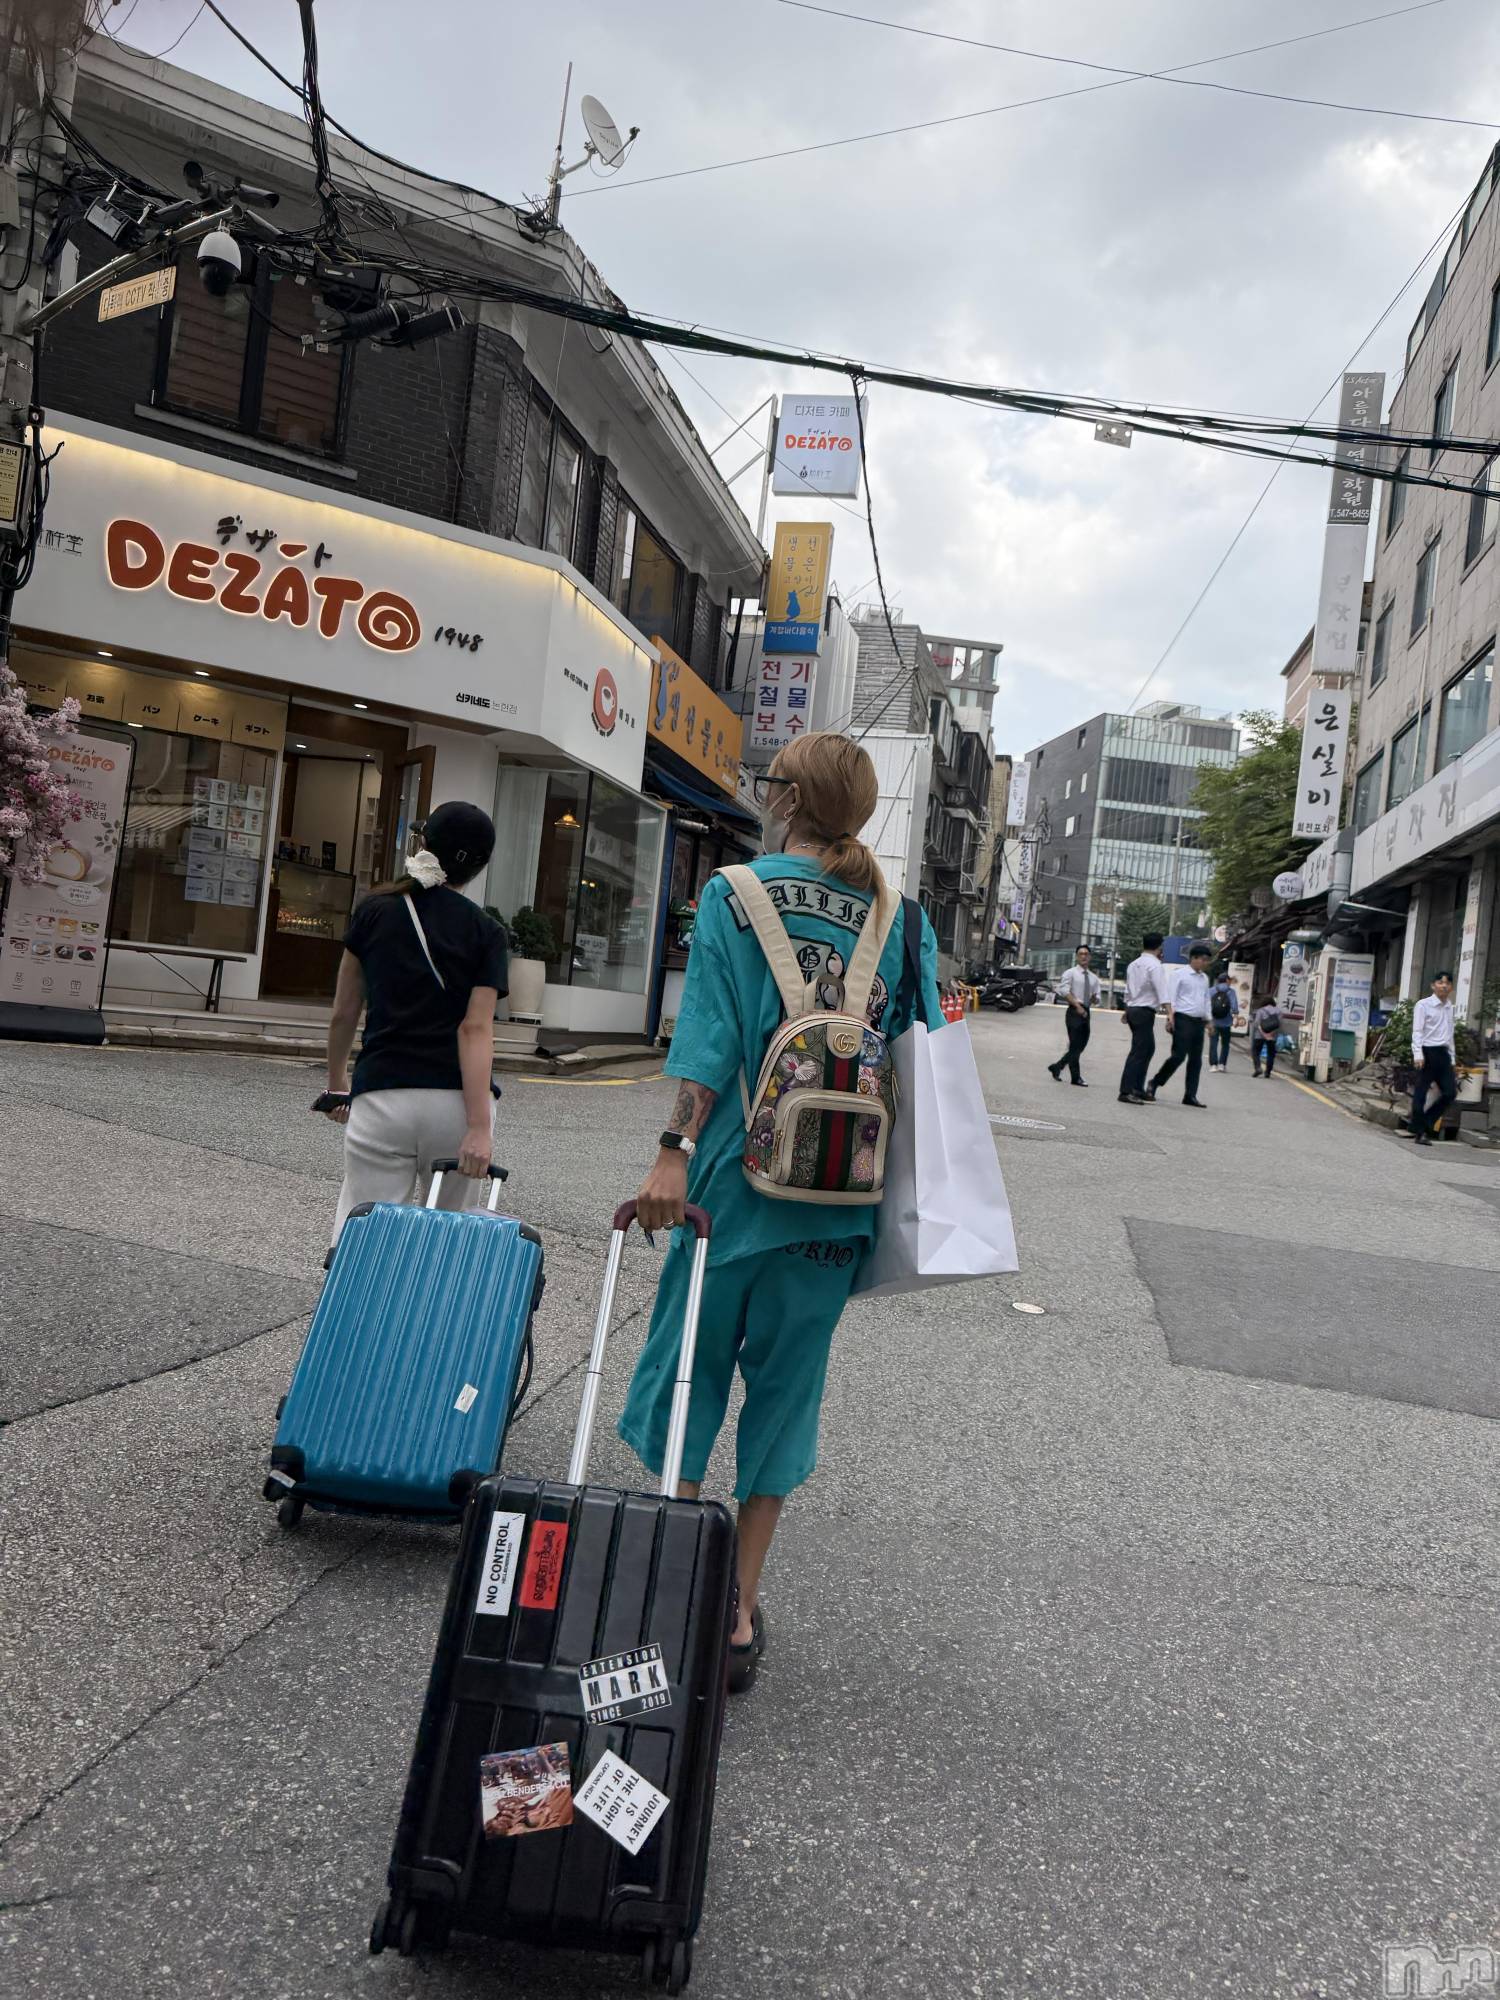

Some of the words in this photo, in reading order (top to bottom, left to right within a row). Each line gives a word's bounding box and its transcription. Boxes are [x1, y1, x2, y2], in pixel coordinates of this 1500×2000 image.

[125, 284, 147, 306] CCTV
[794, 405, 825, 417] 디저트
[828, 406, 851, 417] 카페
[785, 434, 853, 451] DEZATO
[434, 625, 484, 652] 1948
[761, 660, 811, 683] 전기
[758, 685, 807, 709] 철물
[755, 712, 805, 734] 보수
[753, 736, 790, 746] T.548-0
[490, 1522, 510, 1582] CONTROL
[485, 1585, 498, 1604] NO
[583, 1647, 657, 1678] EXTENSION
[587, 1664, 661, 1707] MARK
[590, 1706, 622, 1724] SINCE
[611, 1769, 624, 1786] OF
[624, 1775, 640, 1796] THE
[594, 1787, 615, 1812] LIFE
[625, 1802, 639, 1817] IS
[601, 1796, 627, 1829] LIGHT
[627, 1793, 661, 1845] JOURNEY
